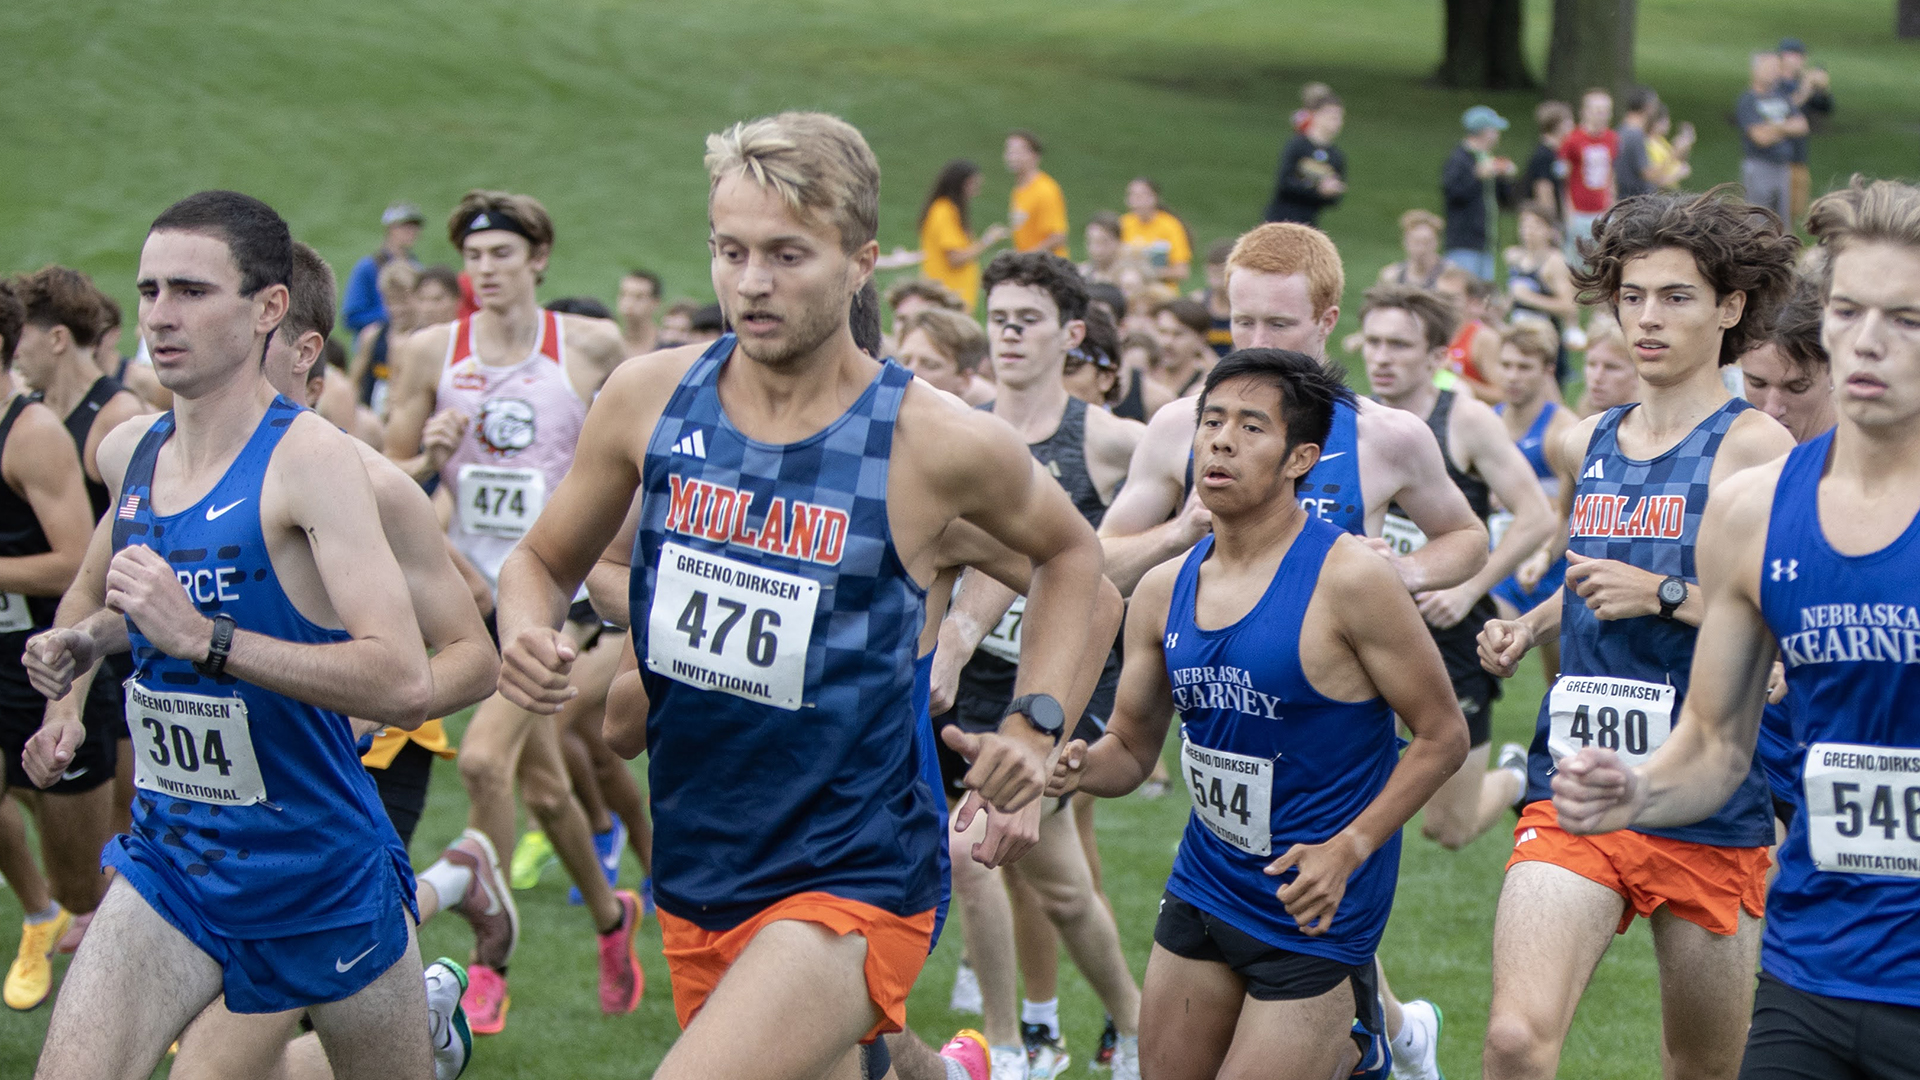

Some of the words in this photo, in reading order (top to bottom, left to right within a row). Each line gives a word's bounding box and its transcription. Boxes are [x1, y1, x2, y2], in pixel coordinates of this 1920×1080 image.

[473, 486, 526, 517] 474
[665, 473, 849, 566] MIDLAND
[1570, 494, 1686, 539] MIDLAND
[177, 567, 239, 603] RCE
[677, 555, 801, 601] GREENO/DIRKSEN
[676, 590, 782, 668] 476
[1801, 603, 1920, 630] NEBRASKA
[672, 659, 772, 698] INVITATIONAL
[1173, 666, 1253, 688] NEBRASKA
[1566, 680, 1660, 701] GREENO/DIRKSEN
[132, 688, 230, 718] GREENO/DIRKSEN
[142, 717, 233, 776] 304
[1570, 704, 1648, 755] 480
[156, 775, 240, 800] INVITATIONAL
[1190, 766, 1251, 826] 544
[1201, 813, 1251, 848] TATIONAL
[1832, 782, 1920, 842] 546
